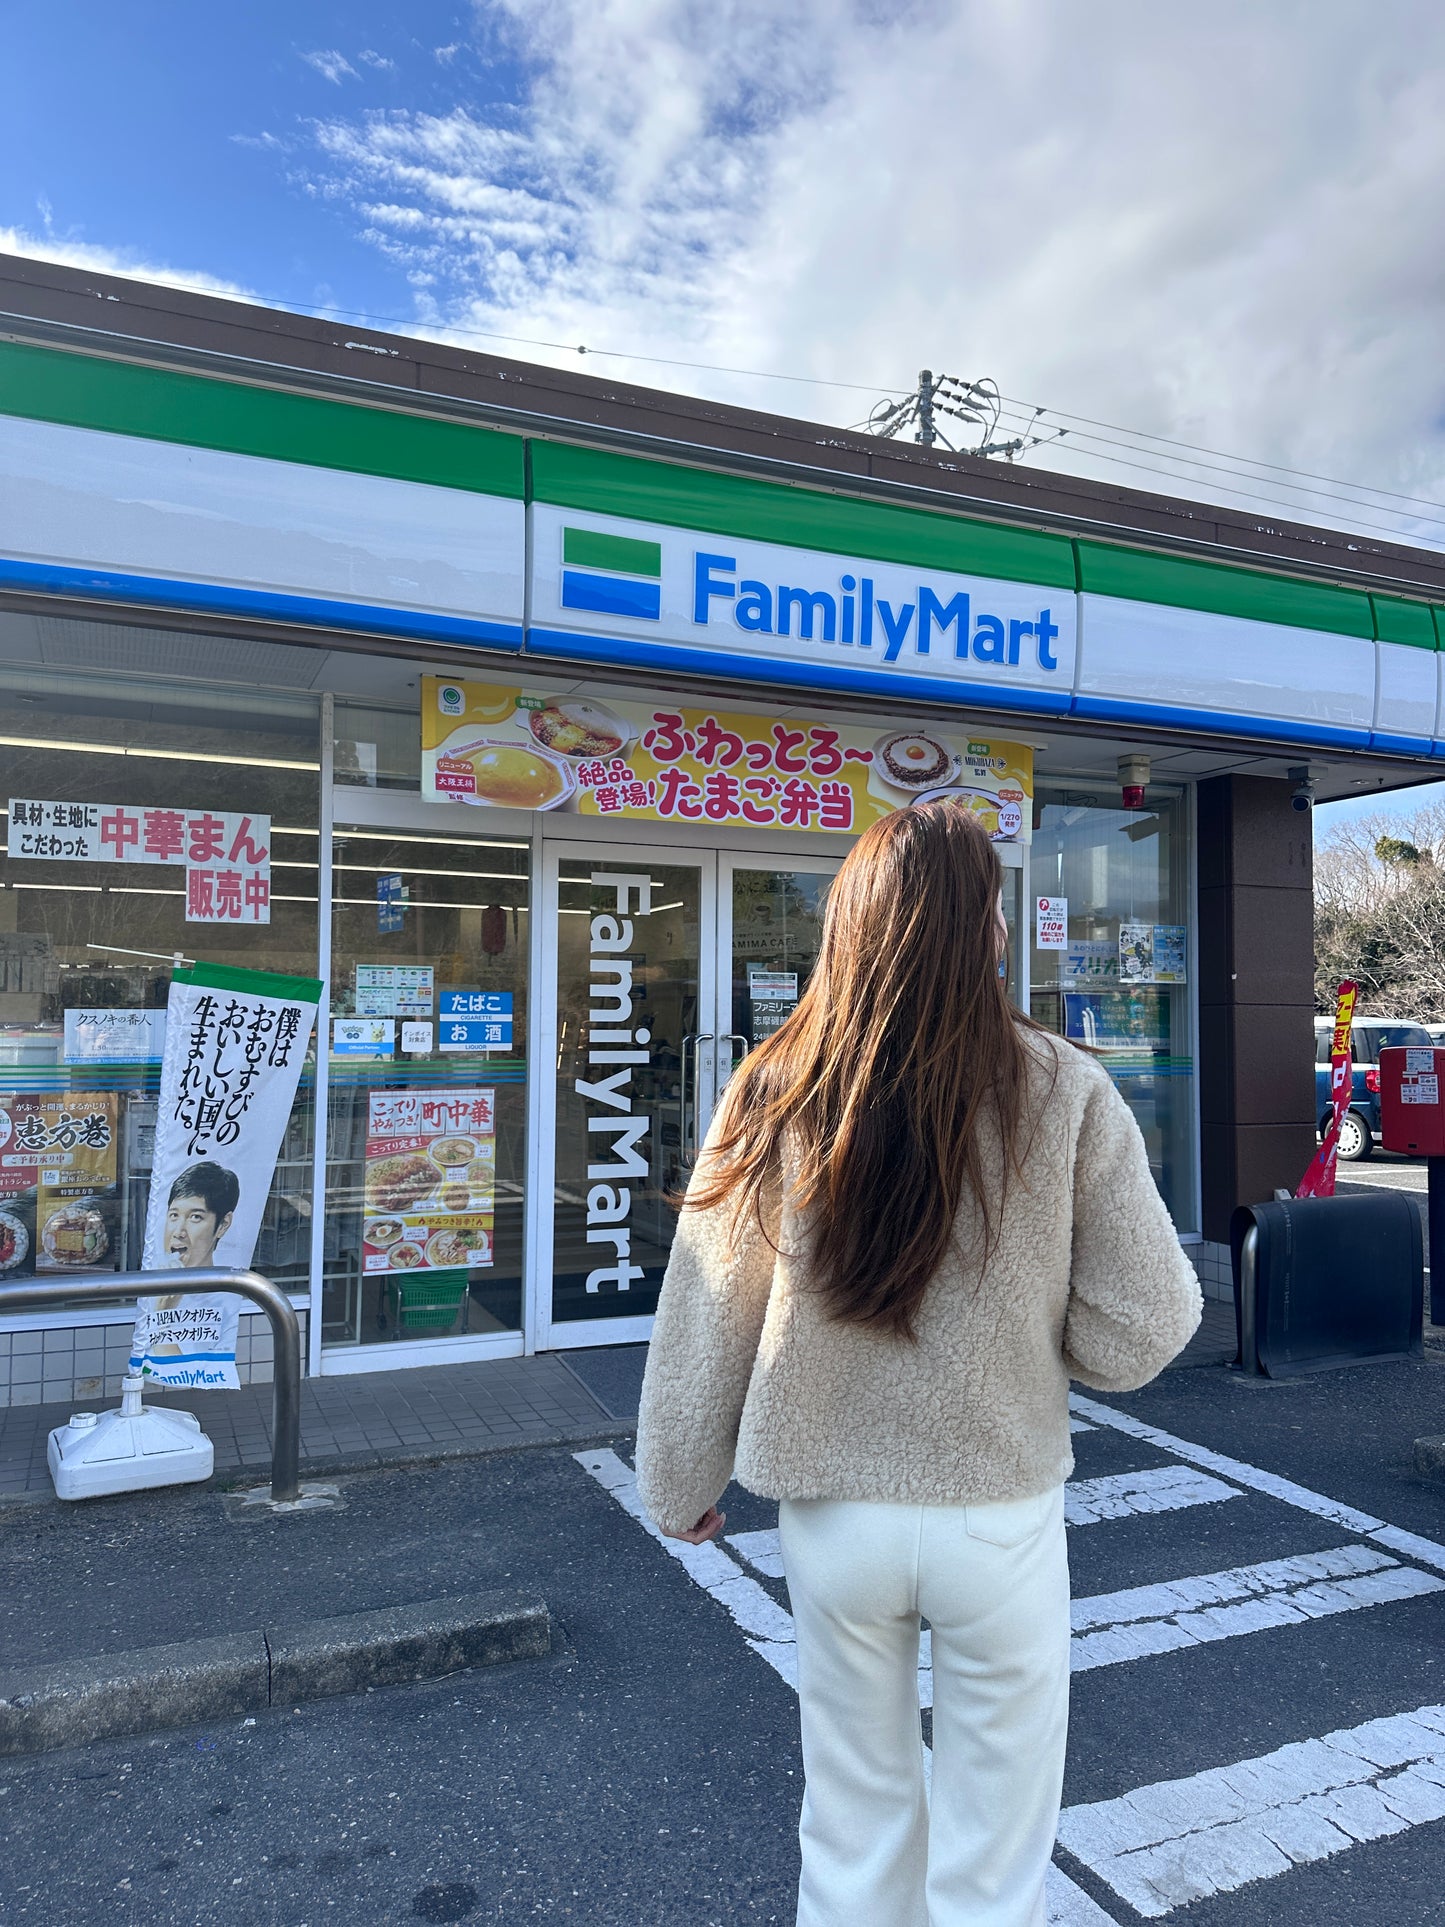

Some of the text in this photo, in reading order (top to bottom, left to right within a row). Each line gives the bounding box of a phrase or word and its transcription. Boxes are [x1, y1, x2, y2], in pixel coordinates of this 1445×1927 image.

[694, 551, 1058, 670] FamilyMart
[439, 760, 472, 771] リニューアル
[577, 762, 633, 788] 絶品
[438, 777, 473, 789] 大阪王将
[659, 768, 851, 829] たまご弁当
[12, 802, 98, 827] 具材・生地に
[21, 834, 89, 857] こだわった
[101, 808, 268, 865] 中華まん
[188, 869, 269, 919] 販売中
[451, 994, 501, 1012] たばこ
[77, 1013, 152, 1026] クスノキの番人
[451, 1024, 502, 1041] お 酒
[268, 1007, 301, 1067] 僕は
[346, 1032, 360, 1040] GO
[188, 999, 248, 1156] おいしい国に
[216, 1003, 276, 1146] おむすびの
[574, 872, 652, 1294] FamilyMart
[374, 1098, 493, 1128] こってり 町中華
[15, 1113, 110, 1150] 恵方巻
[11, 1155, 65, 1165] ご予約承り中
